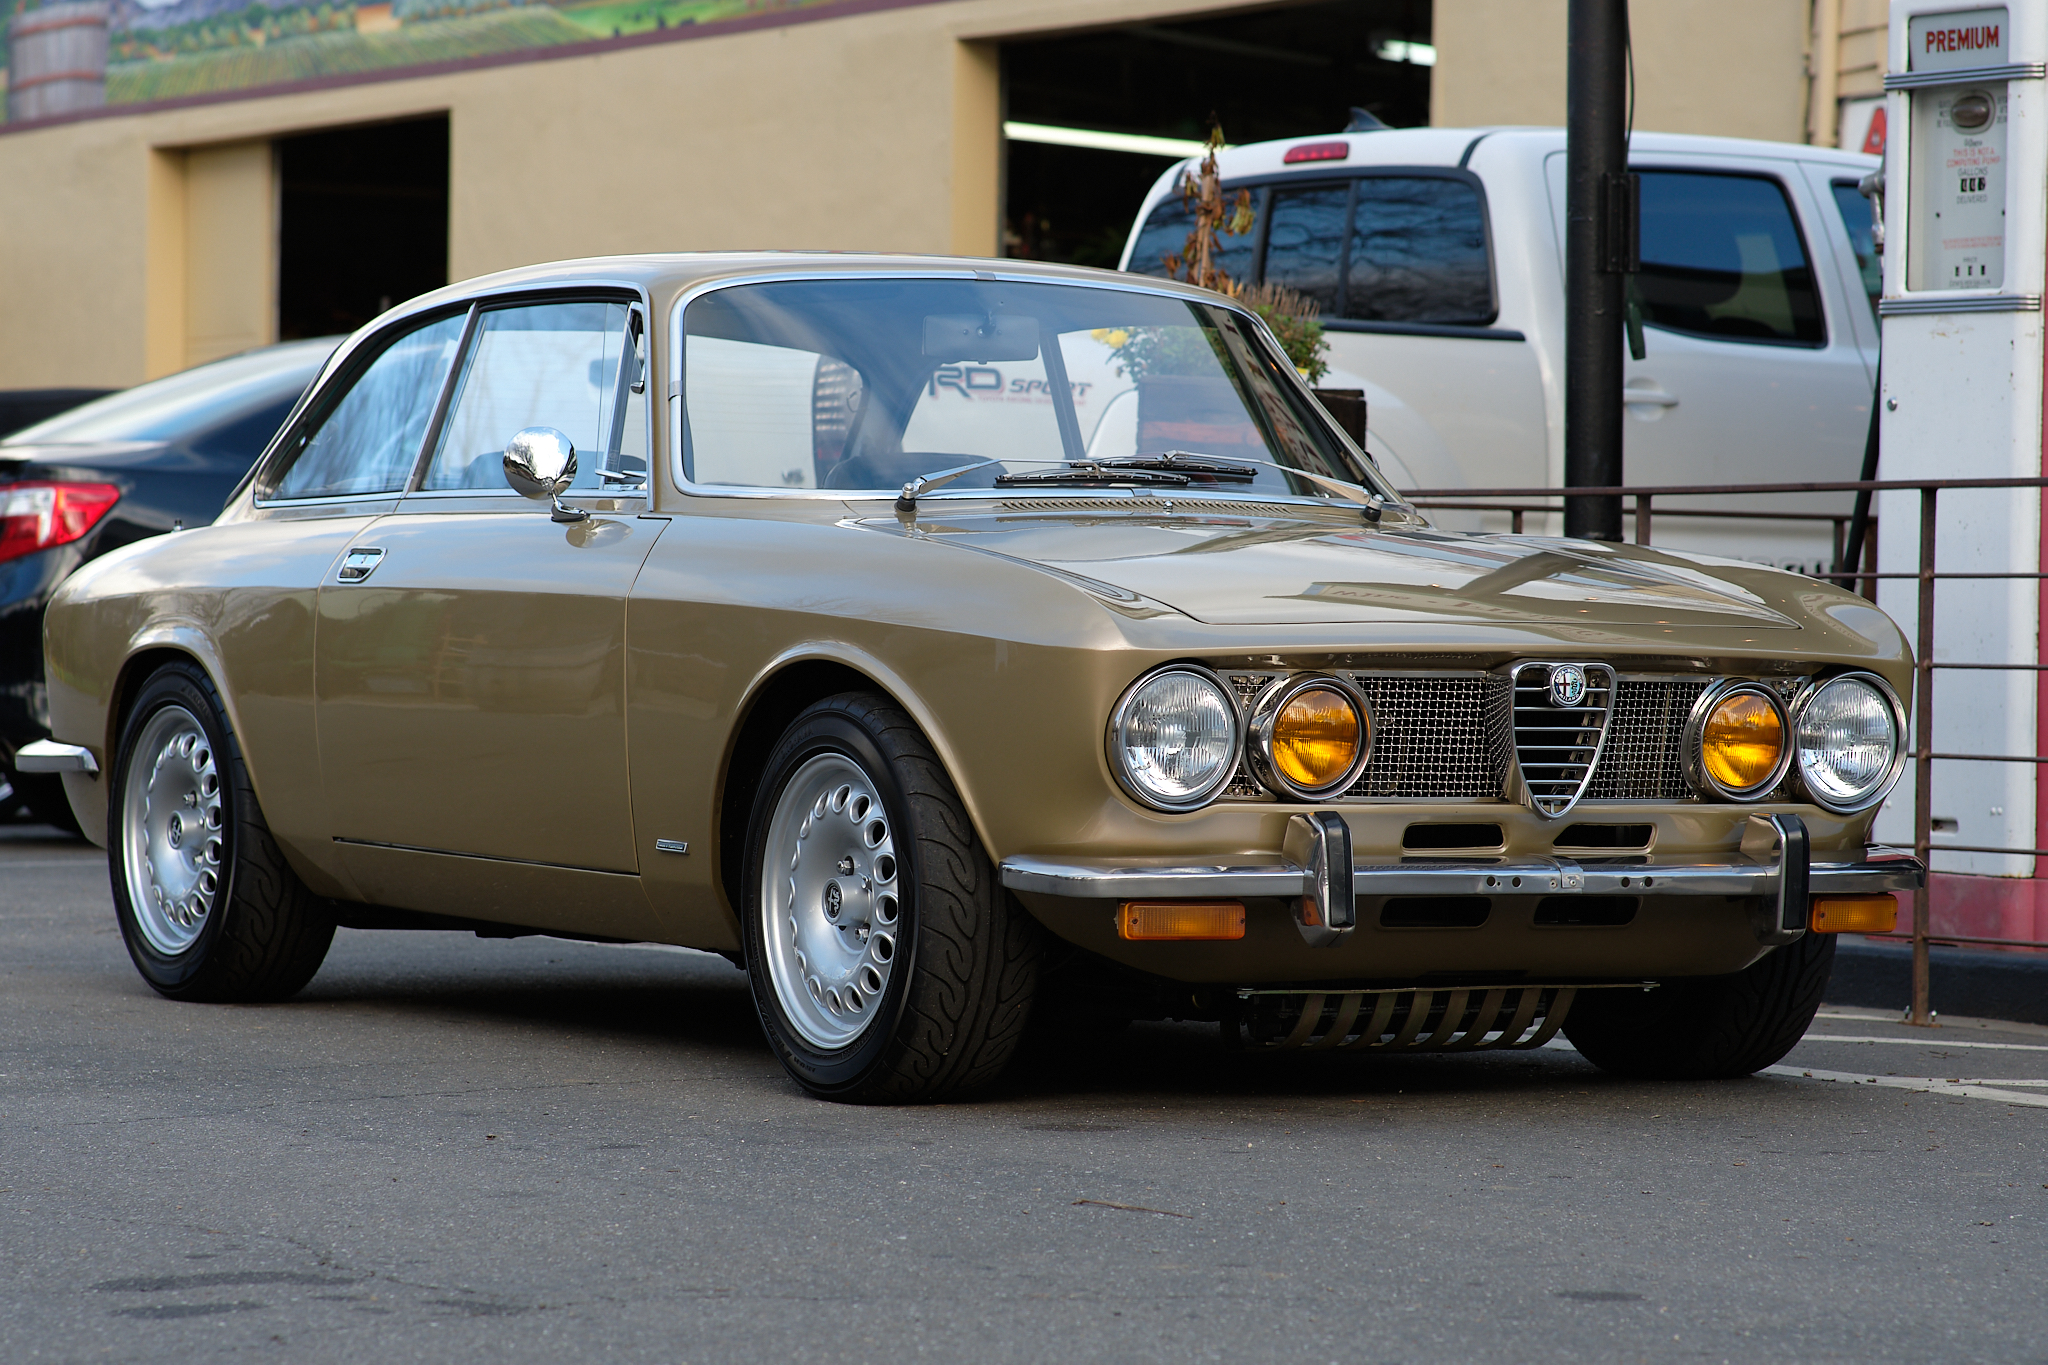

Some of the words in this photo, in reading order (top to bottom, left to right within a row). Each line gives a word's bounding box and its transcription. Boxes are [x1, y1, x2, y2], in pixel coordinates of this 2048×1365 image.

[1926, 25, 1999, 53] PREMIUM
[1957, 166, 1989, 176] GALLONS
[928, 366, 1003, 399] RD
